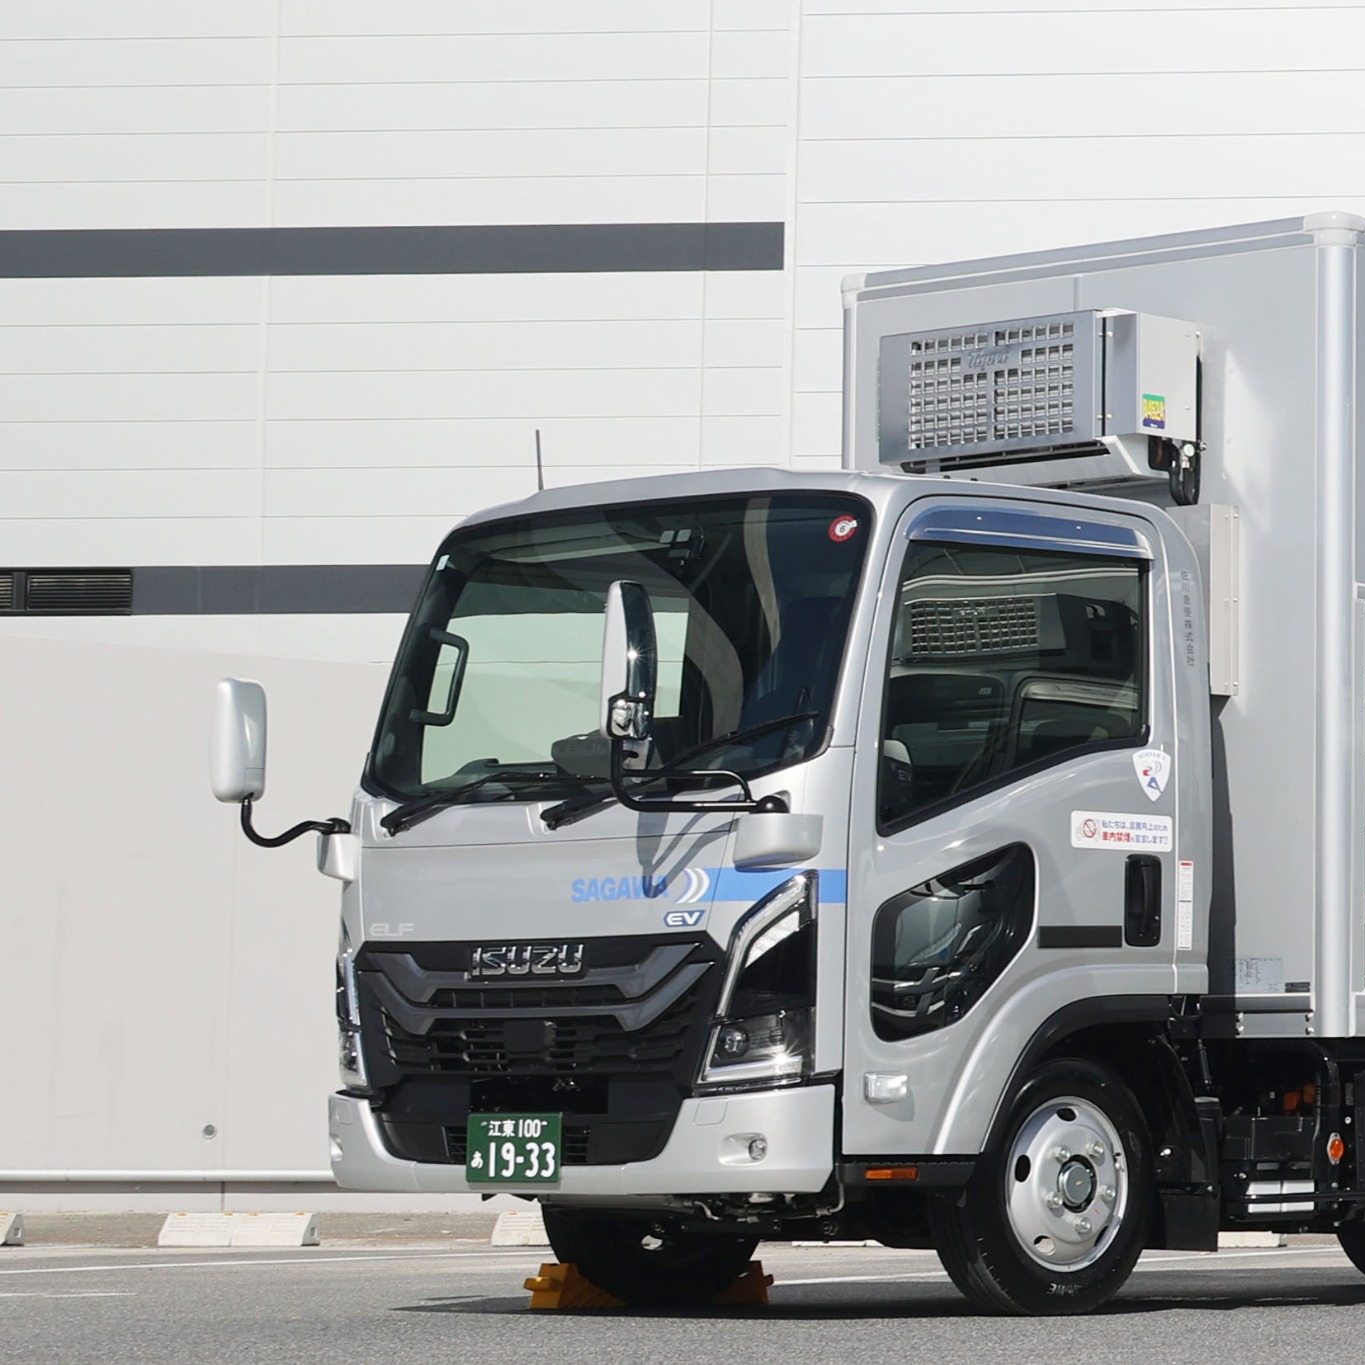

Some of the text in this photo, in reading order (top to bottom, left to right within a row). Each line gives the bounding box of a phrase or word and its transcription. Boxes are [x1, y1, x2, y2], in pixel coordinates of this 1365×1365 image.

[571, 875, 669, 903] SAGAWA
[370, 923, 414, 937] ELF
[666, 912, 701, 926] EV
[472, 943, 585, 976] ISUZU
[488, 1118, 541, 1138] 江東 100
[470, 1142, 556, 1178] あ 19-33
